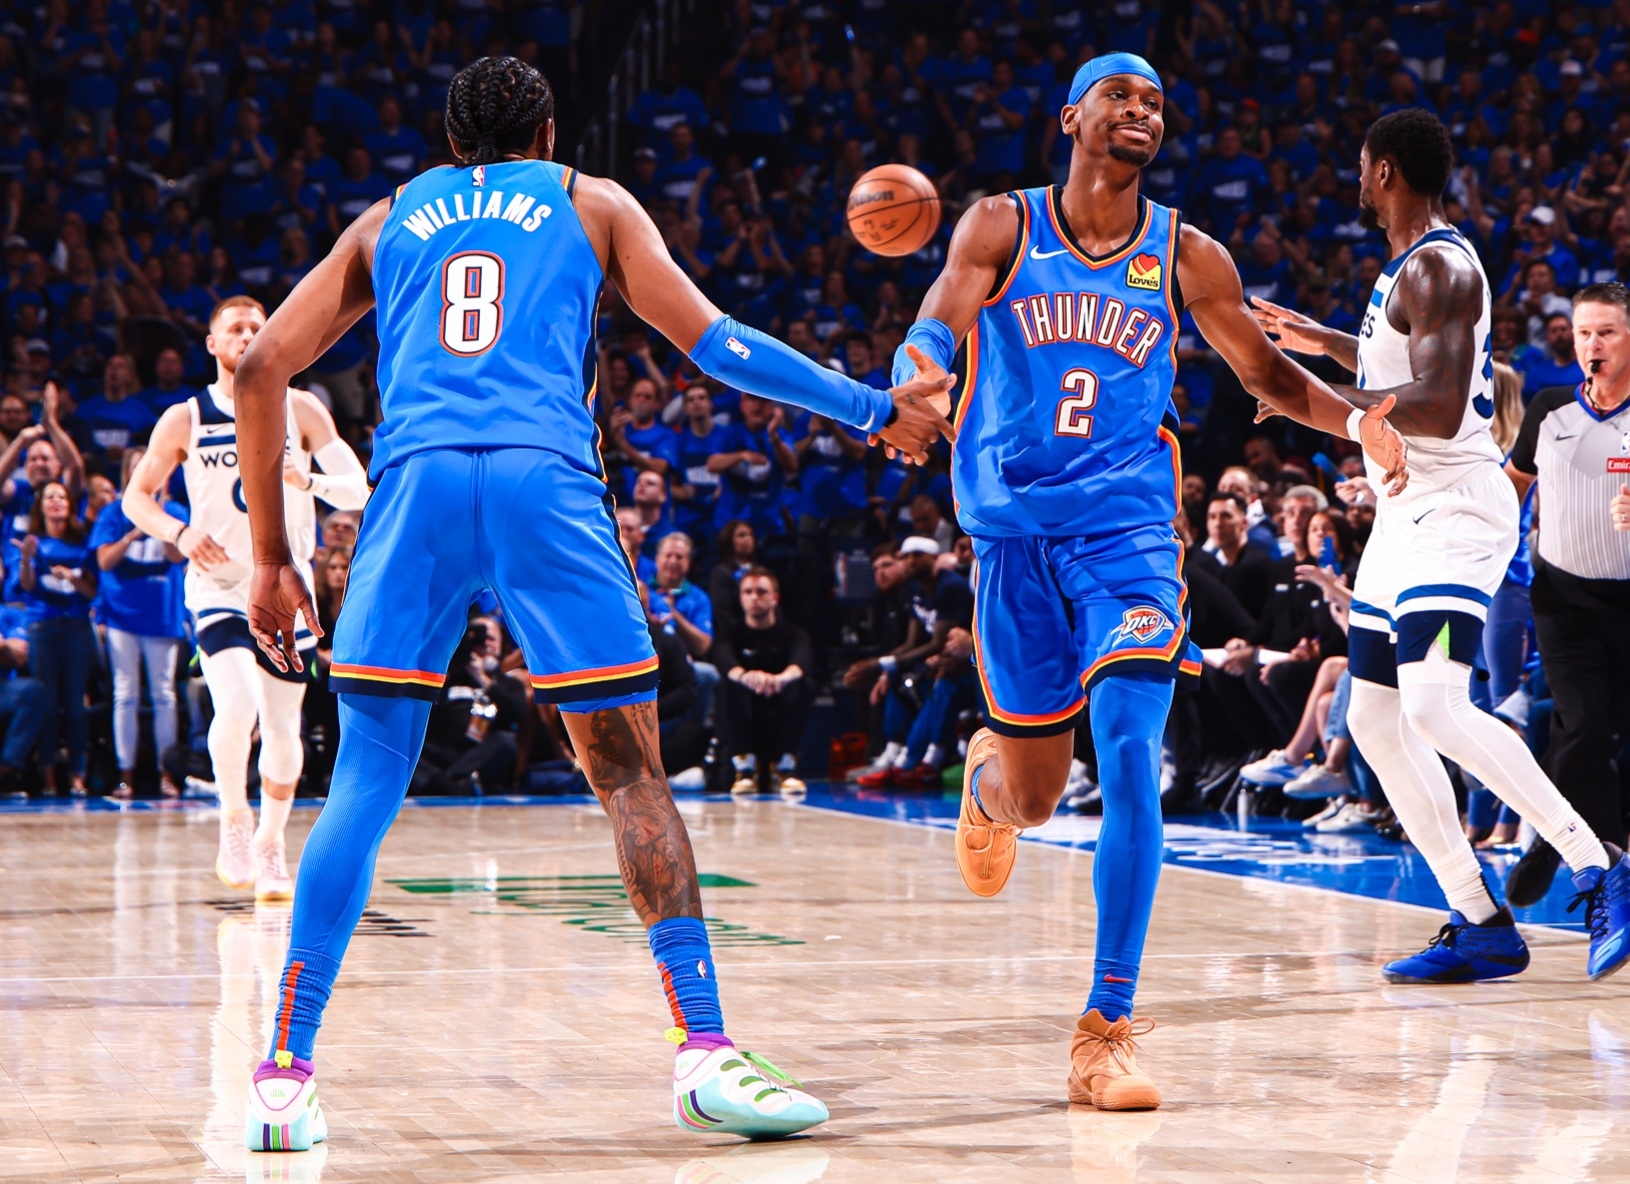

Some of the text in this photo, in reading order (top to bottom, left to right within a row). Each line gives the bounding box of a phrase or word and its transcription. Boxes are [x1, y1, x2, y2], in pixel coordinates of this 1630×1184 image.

[402, 191, 552, 241] WILLIAMS
[438, 250, 506, 358] 8
[1011, 292, 1164, 368] THUNDER
[1054, 367, 1100, 438] 2
[1608, 460, 1630, 470] Emir
[1122, 615, 1158, 635] OKC
